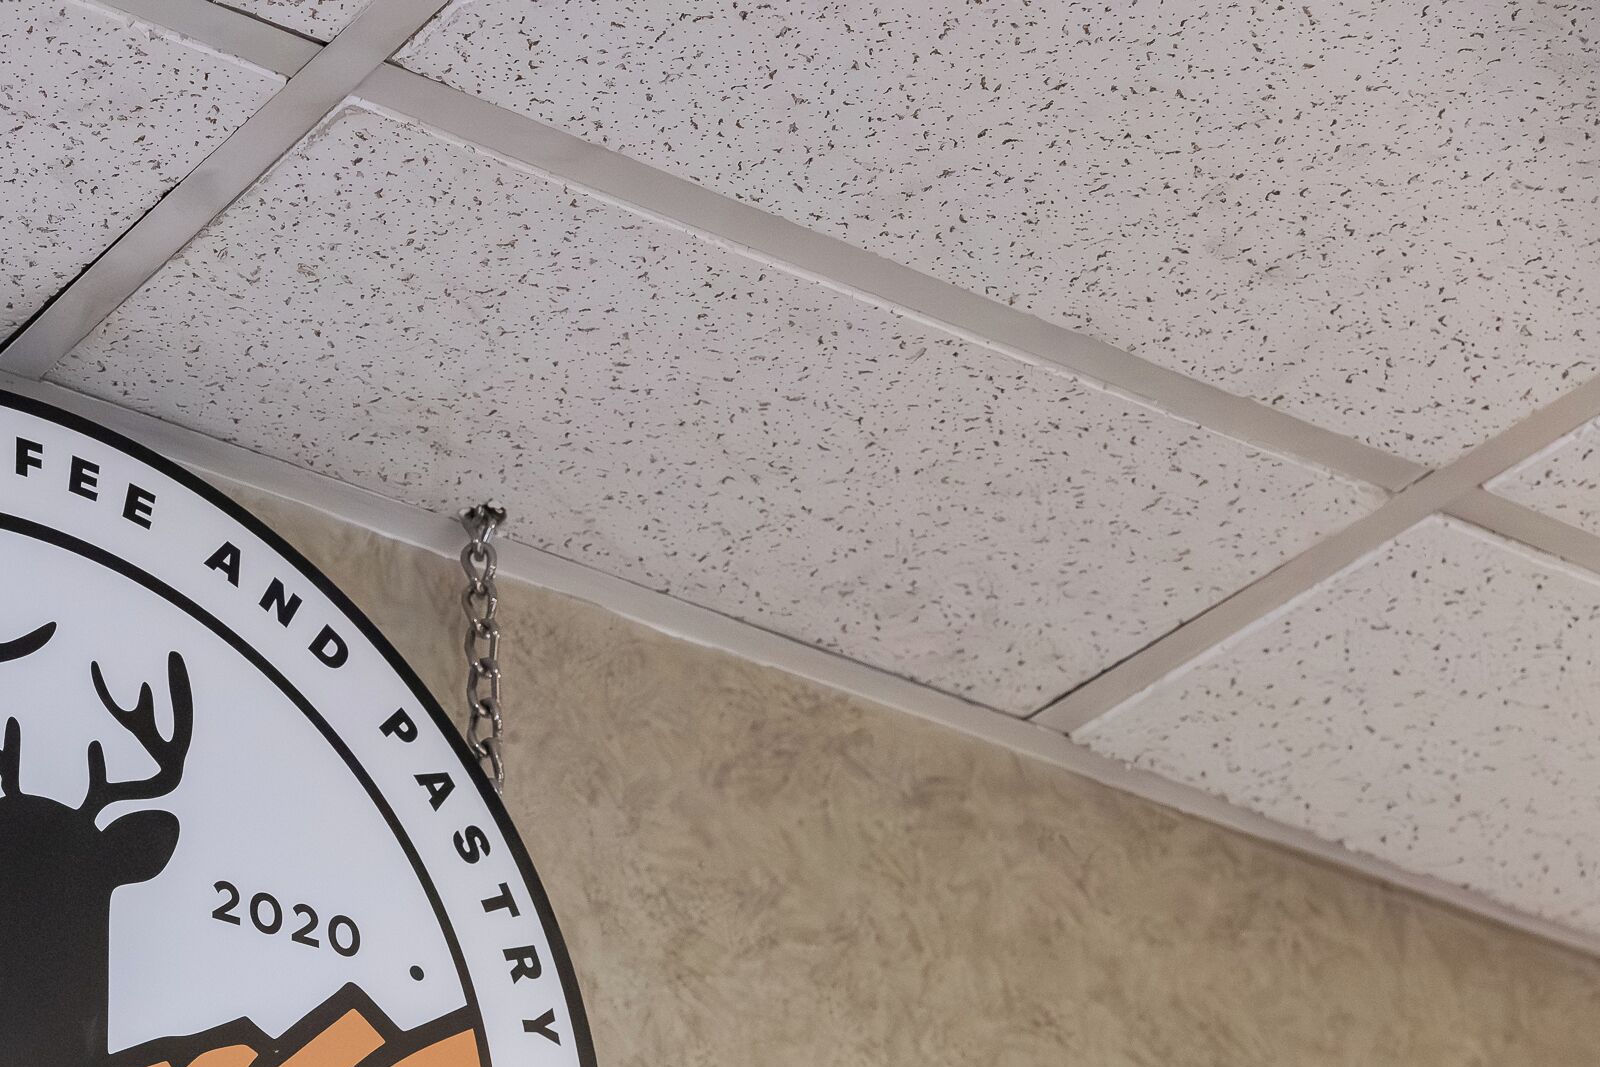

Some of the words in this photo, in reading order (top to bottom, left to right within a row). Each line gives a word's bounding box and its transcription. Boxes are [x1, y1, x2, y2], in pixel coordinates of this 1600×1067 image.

[203, 540, 349, 669] AND
[378, 707, 561, 1047] PASTRY
[211, 880, 361, 957] 2020
